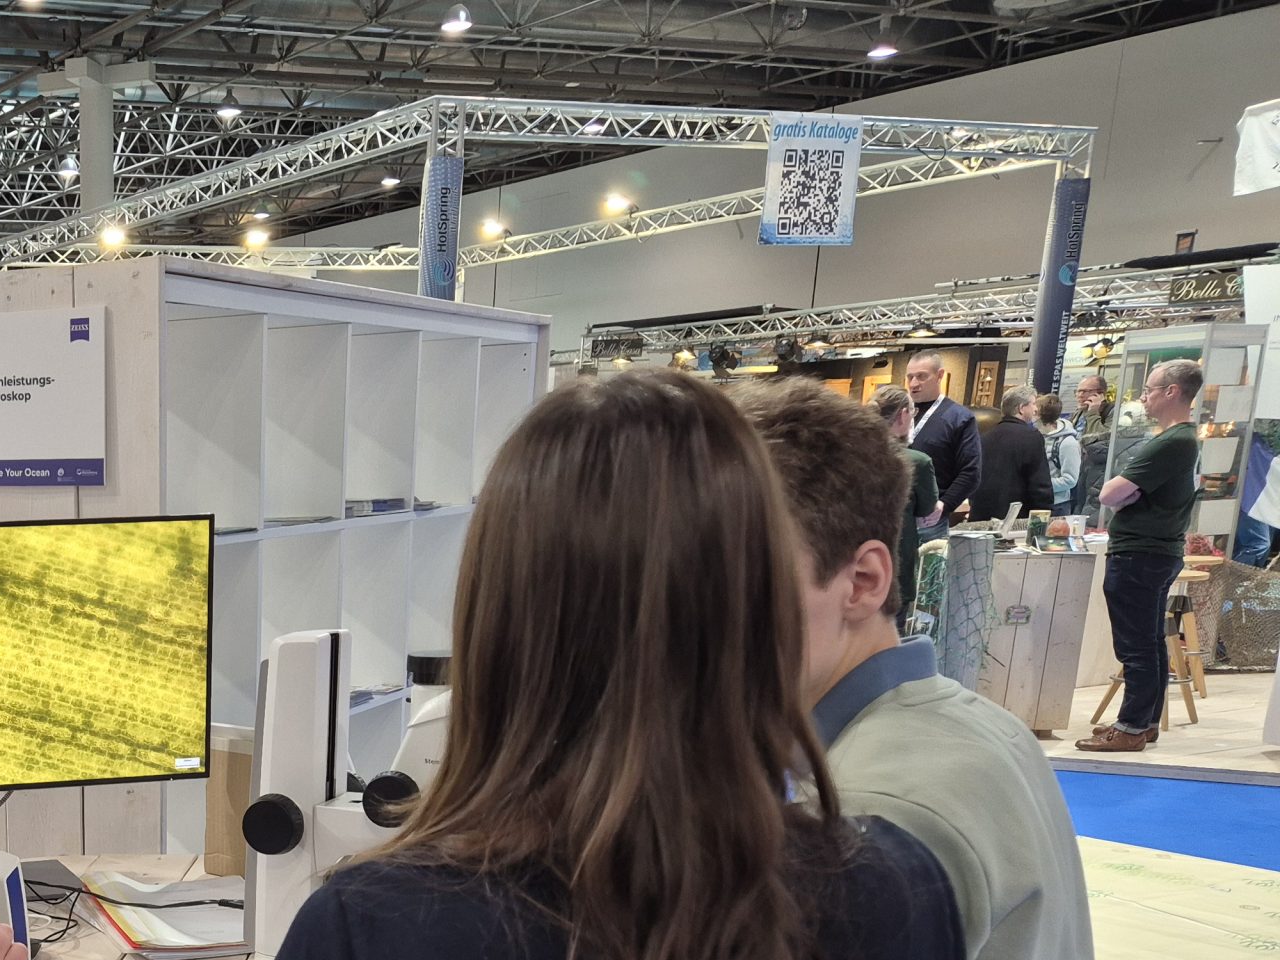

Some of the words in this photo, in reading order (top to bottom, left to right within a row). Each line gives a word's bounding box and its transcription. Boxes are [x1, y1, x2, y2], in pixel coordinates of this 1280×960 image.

[773, 120, 806, 141] gratis
[808, 121, 859, 144] Kataloge
[437, 186, 451, 253] HotSpring
[1065, 201, 1085, 259] HotSpring
[1171, 279, 1223, 301] Bella
[1056, 310, 1070, 358] WELTWEIT
[1053, 358, 1063, 382] SPAS
[1051, 382, 1059, 393] TE
[5, 467, 23, 477] Your
[24, 467, 51, 477] Ocean
